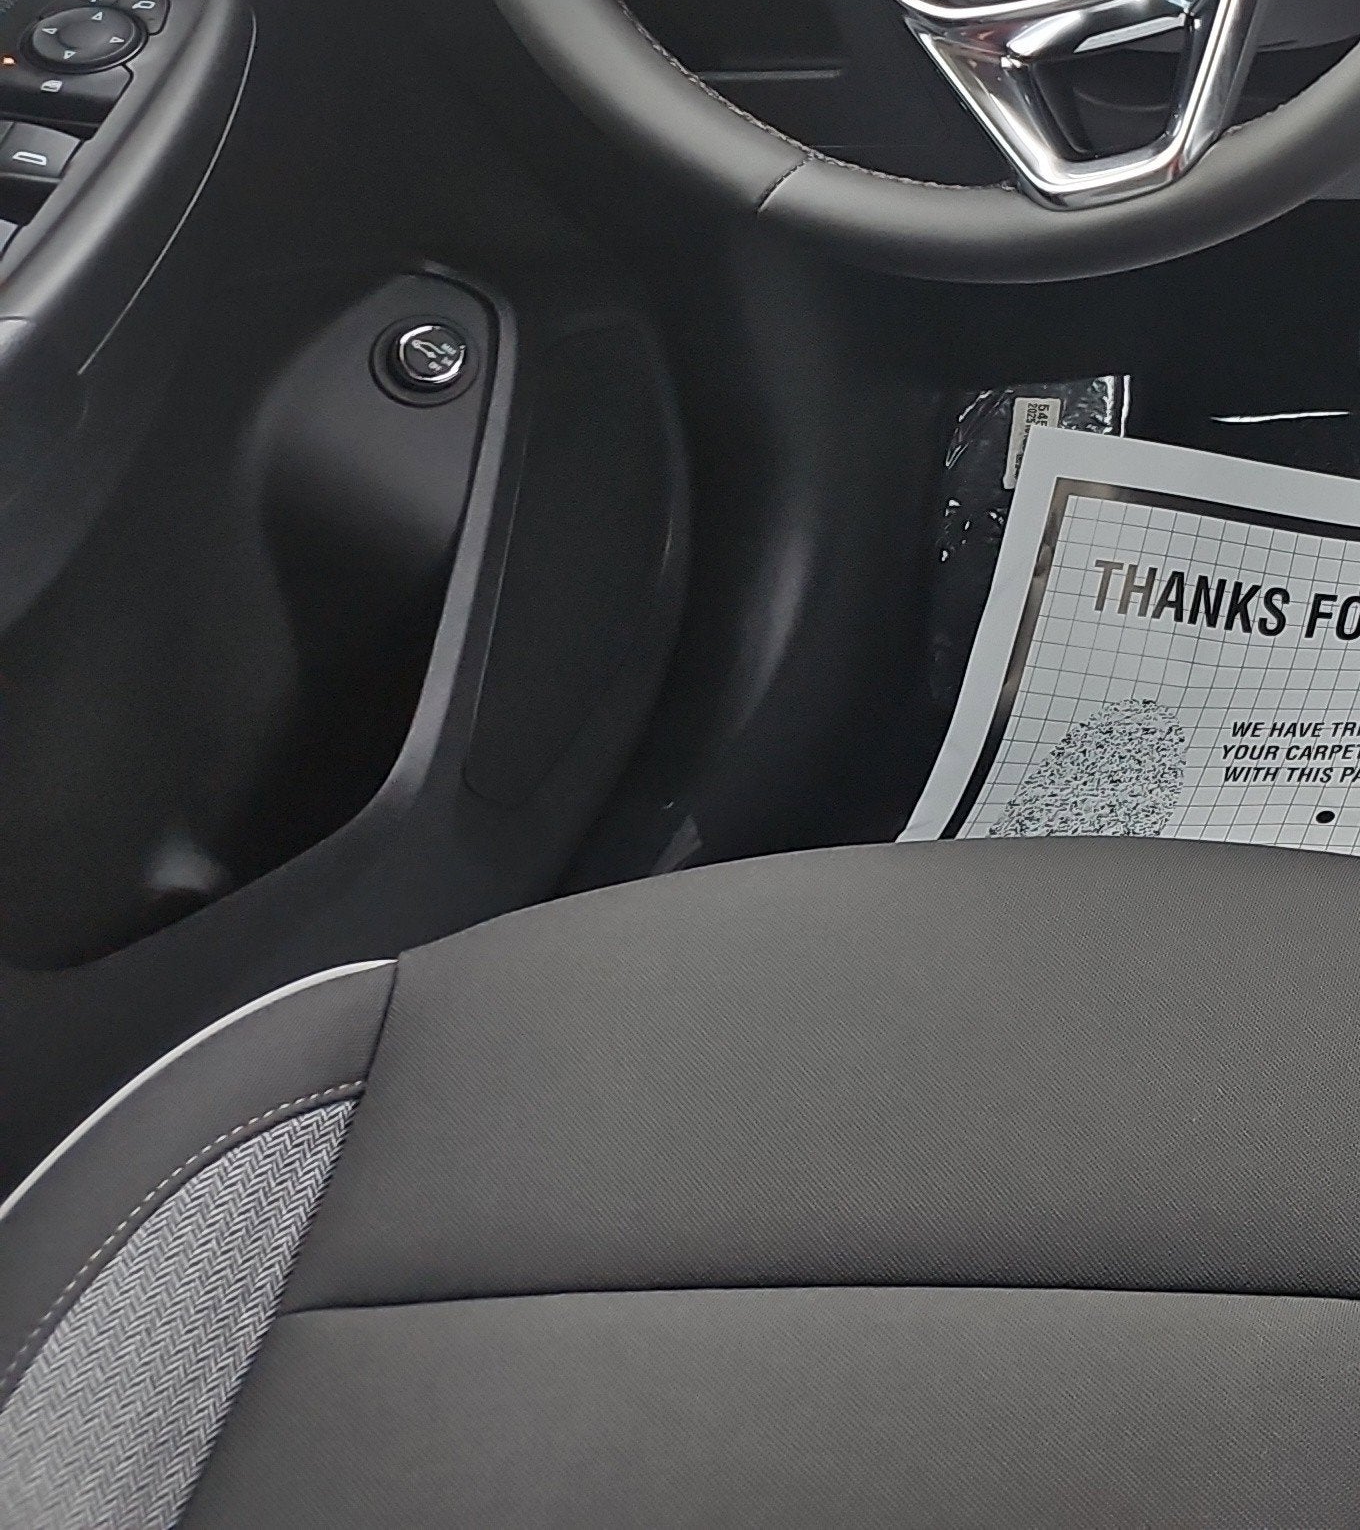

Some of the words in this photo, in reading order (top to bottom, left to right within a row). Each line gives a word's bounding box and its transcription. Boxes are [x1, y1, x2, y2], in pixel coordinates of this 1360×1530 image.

[1093, 559, 1291, 638] THANKS
[1231, 721, 1265, 738] WE
[1268, 721, 1324, 738] HAVE
[1221, 744, 1280, 760] YOUR
[1223, 767, 1278, 783] WITH
[1285, 767, 1333, 783] THIS
